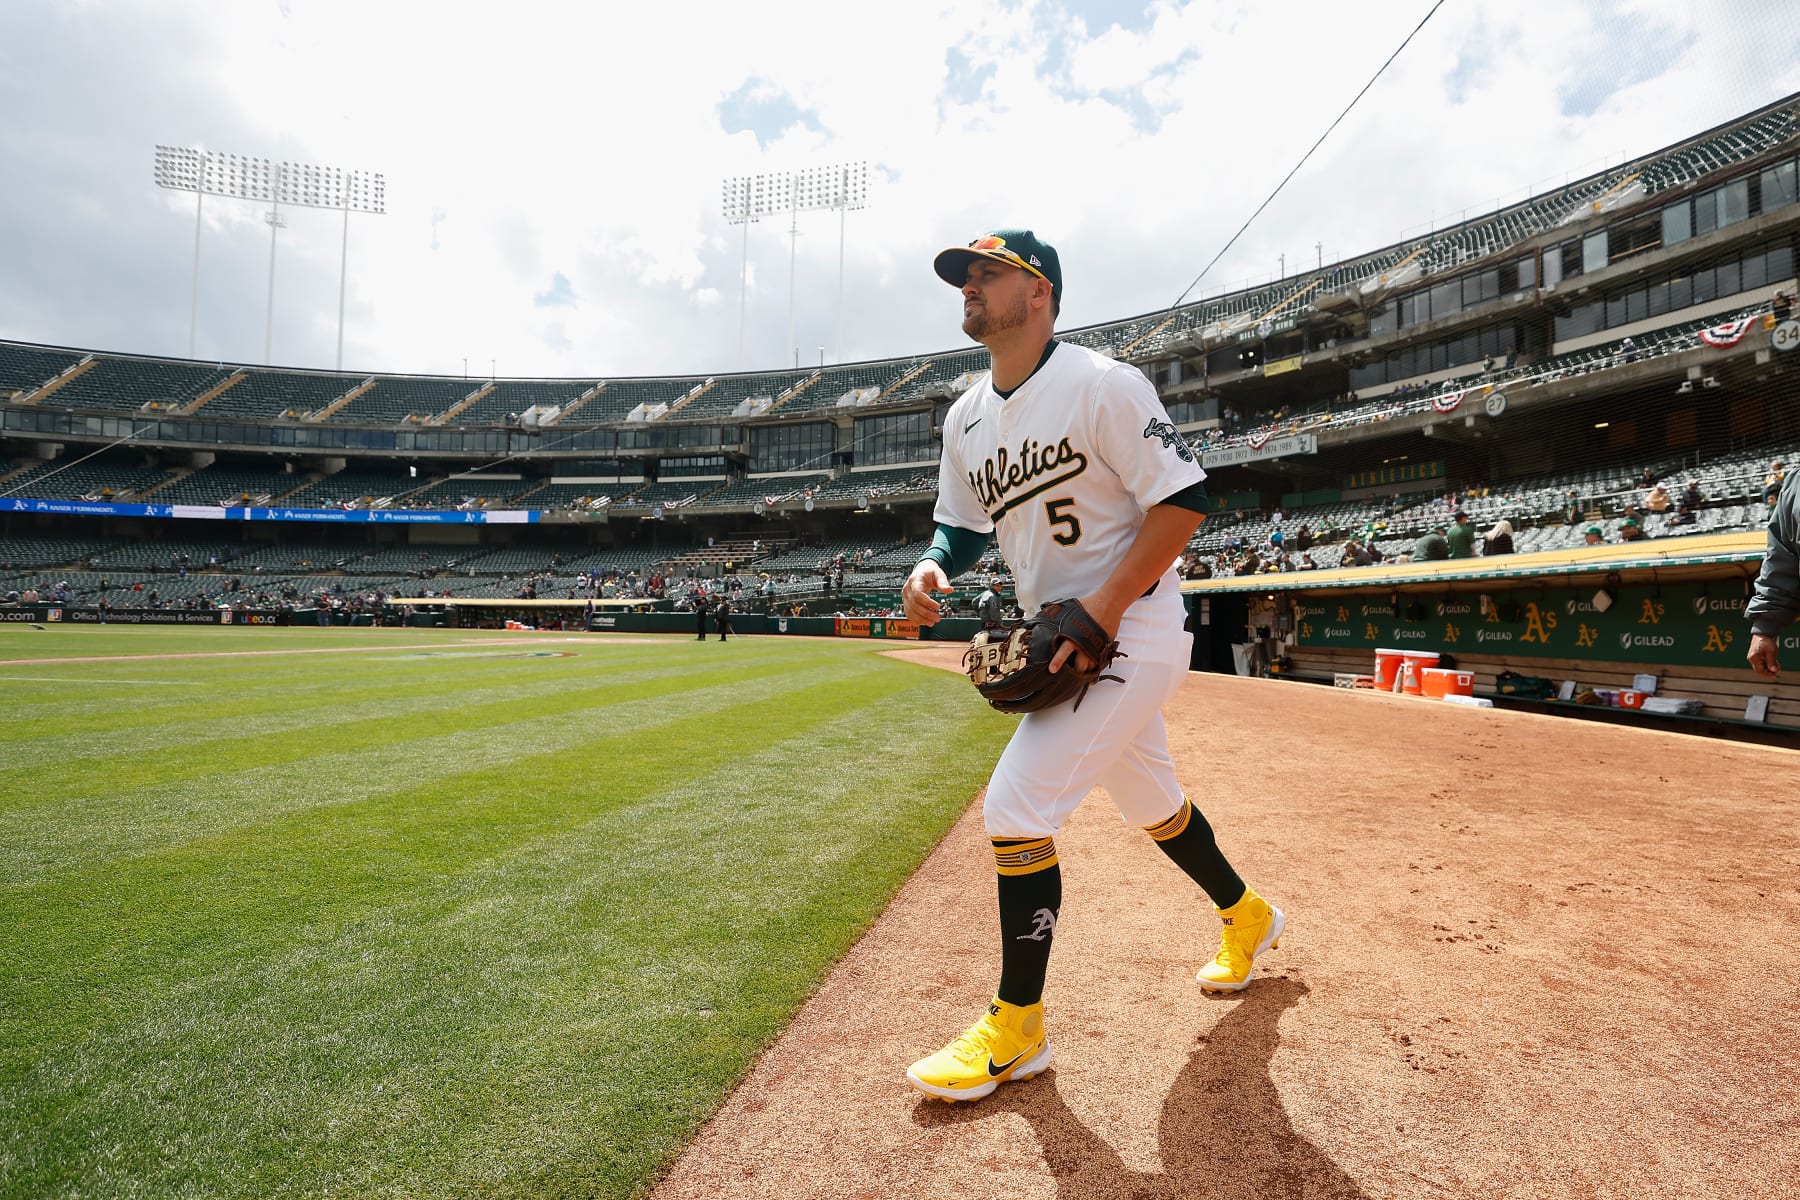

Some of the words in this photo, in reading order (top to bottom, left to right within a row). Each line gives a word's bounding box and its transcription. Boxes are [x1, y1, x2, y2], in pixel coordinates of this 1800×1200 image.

[1777, 325, 1799, 345] 34
[1045, 496, 1082, 547] 5
[1446, 605, 1471, 614] GILEAD
[1710, 599, 1746, 611] GILEA
[98, 612, 140, 623] Tchnology
[142, 612, 177, 621] Solutions
[185, 613, 214, 622] Services
[1638, 599, 1665, 624] A's
[1520, 602, 1558, 644] A's
[1331, 629, 1351, 637] GILEAD
[1401, 630, 1426, 639] GILEAD
[1485, 631, 1513, 641] GILEAD
[1576, 623, 1598, 647] A's
[1702, 624, 1733, 652] A's
[1634, 635, 1674, 647] GILEAD
[1624, 692, 1635, 705] G
[1221, 917, 1234, 926] IKE
